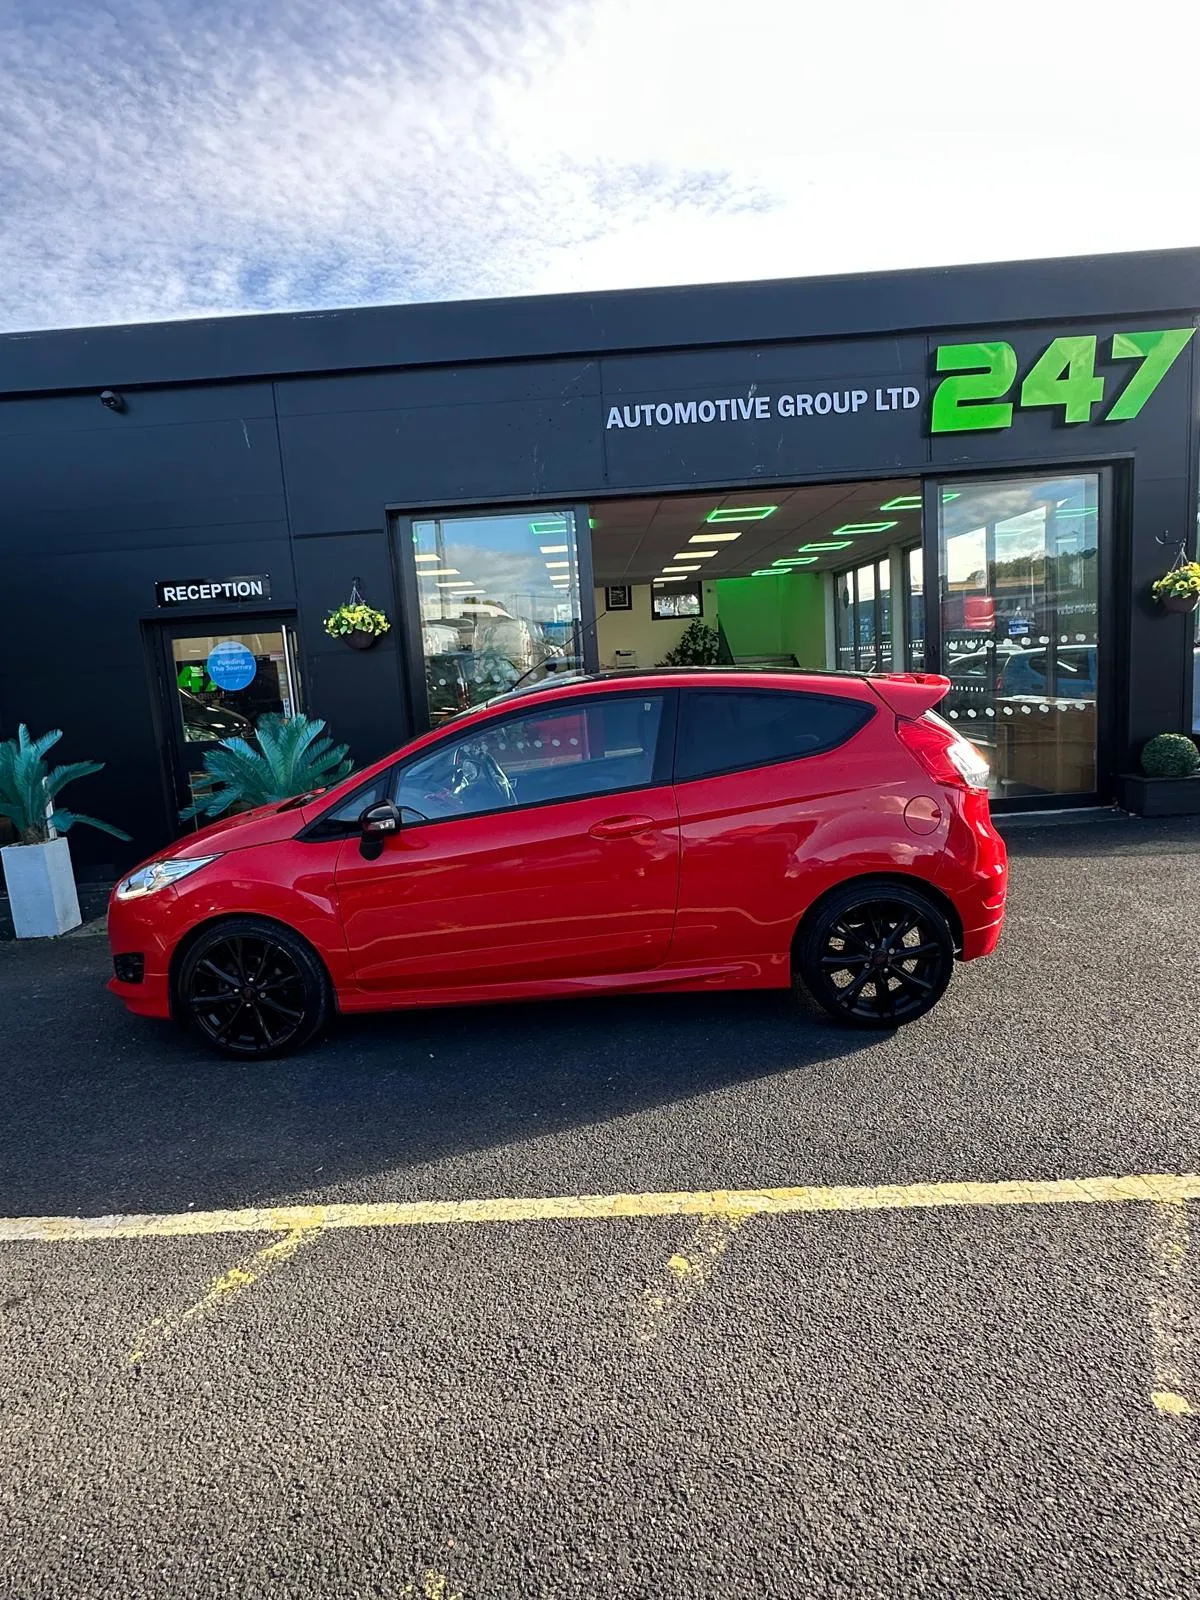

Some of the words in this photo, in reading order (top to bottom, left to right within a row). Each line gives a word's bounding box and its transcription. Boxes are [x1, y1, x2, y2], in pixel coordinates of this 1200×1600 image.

[931, 327, 1196, 433] 247
[606, 397, 771, 429] AUTOMOTIVE
[777, 390, 868, 417] GROUP
[876, 387, 920, 411] LTD
[163, 581, 263, 601] RECEPTION
[217, 658, 246, 666] Funding
